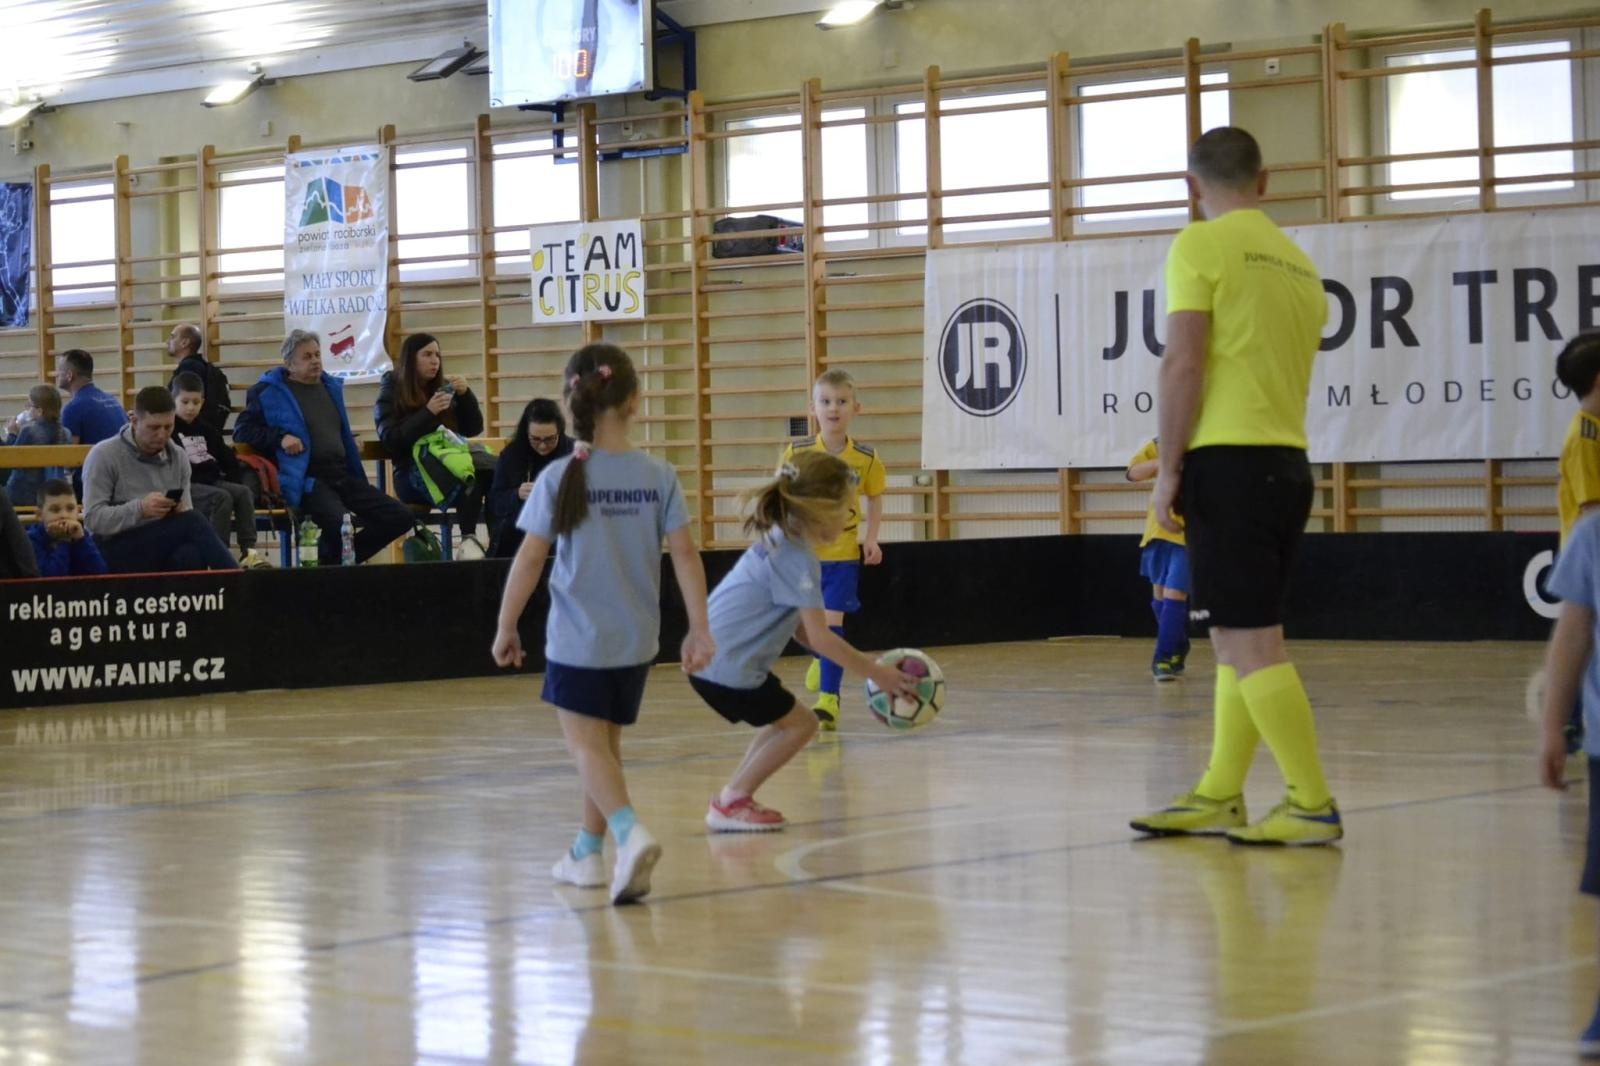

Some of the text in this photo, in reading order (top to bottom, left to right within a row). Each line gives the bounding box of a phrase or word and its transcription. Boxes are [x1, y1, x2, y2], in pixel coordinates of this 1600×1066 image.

[542, 232, 637, 274] TEAM
[335, 270, 376, 288] SPORT
[539, 271, 641, 316] CITRUS
[289, 298, 336, 316] WIELKA
[954, 321, 1012, 390] JR
[585, 488, 660, 504] UPERNOVA
[9, 587, 225, 621] reklamní a cestovní
[50, 620, 187, 650] agentura
[12, 657, 226, 693] WWW.FAINF.CZ
